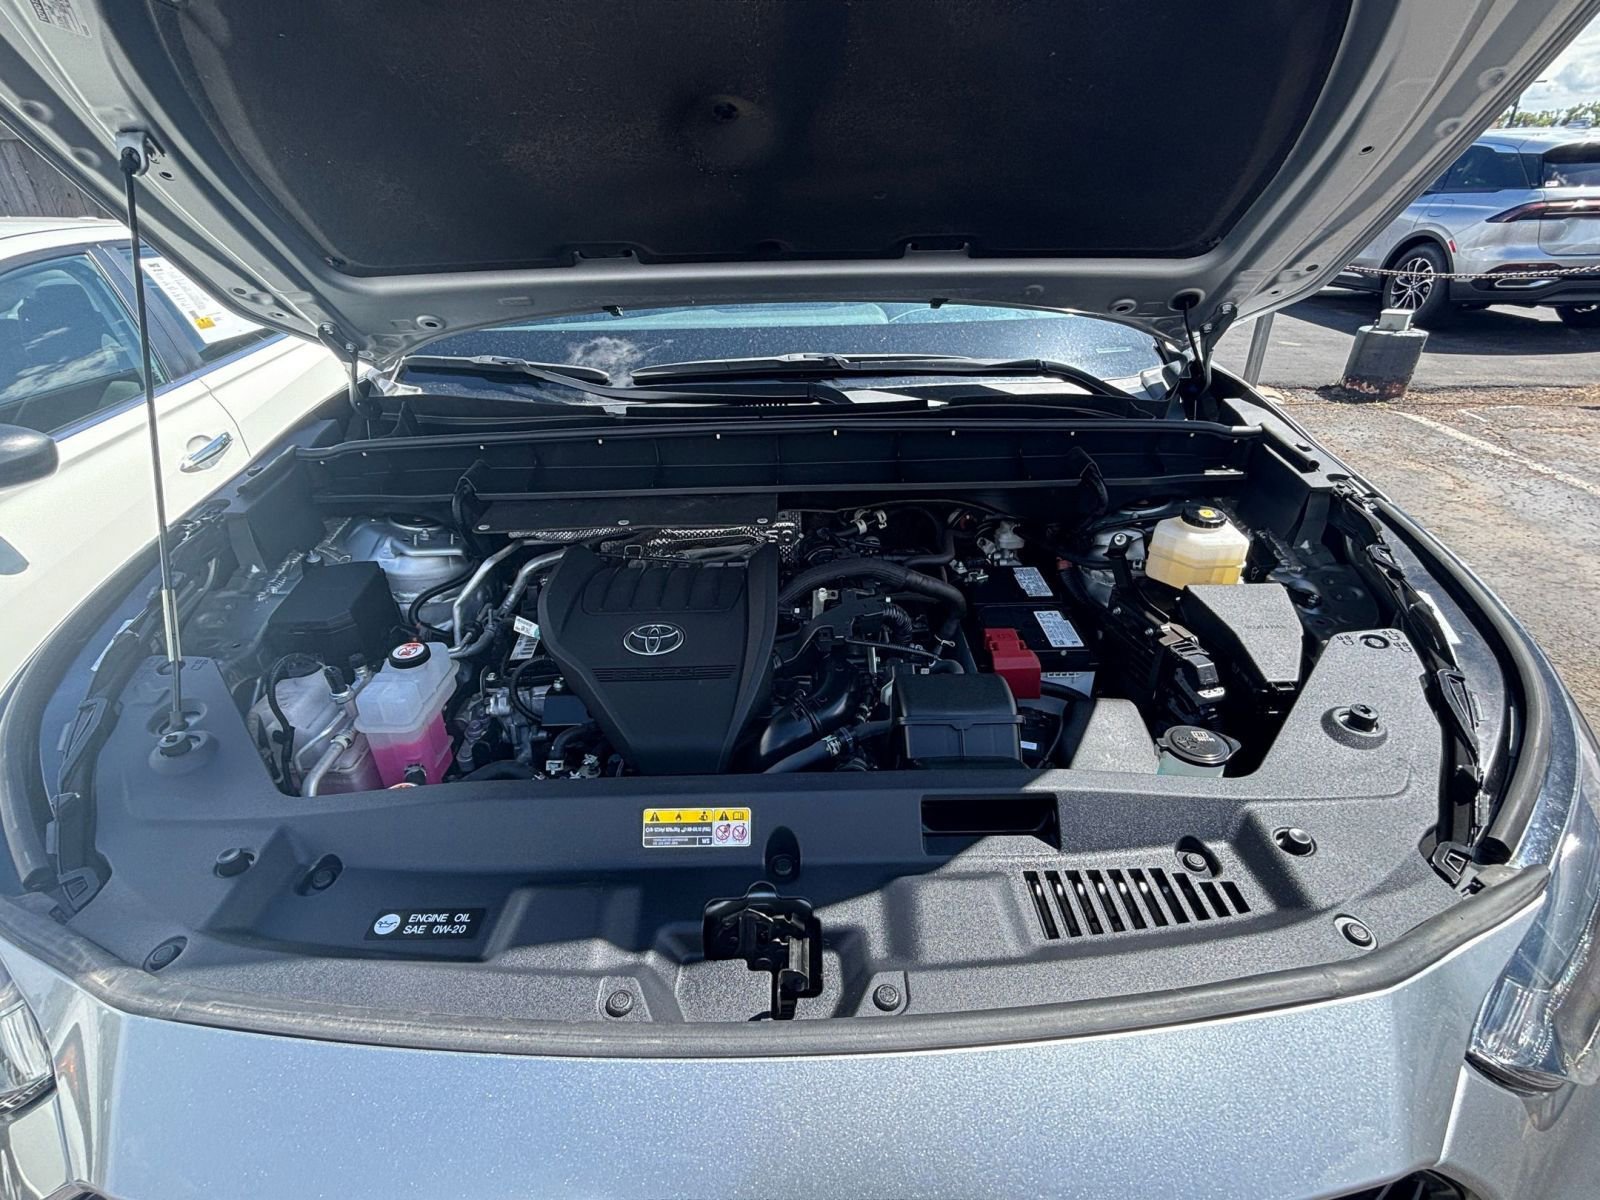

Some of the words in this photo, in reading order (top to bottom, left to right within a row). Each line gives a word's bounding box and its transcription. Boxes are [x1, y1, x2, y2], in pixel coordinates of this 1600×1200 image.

[408, 913, 449, 923] ENGINE
[453, 913, 471, 922] OIL
[402, 924, 427, 934] SAE
[432, 924, 467, 934] 0W-20
